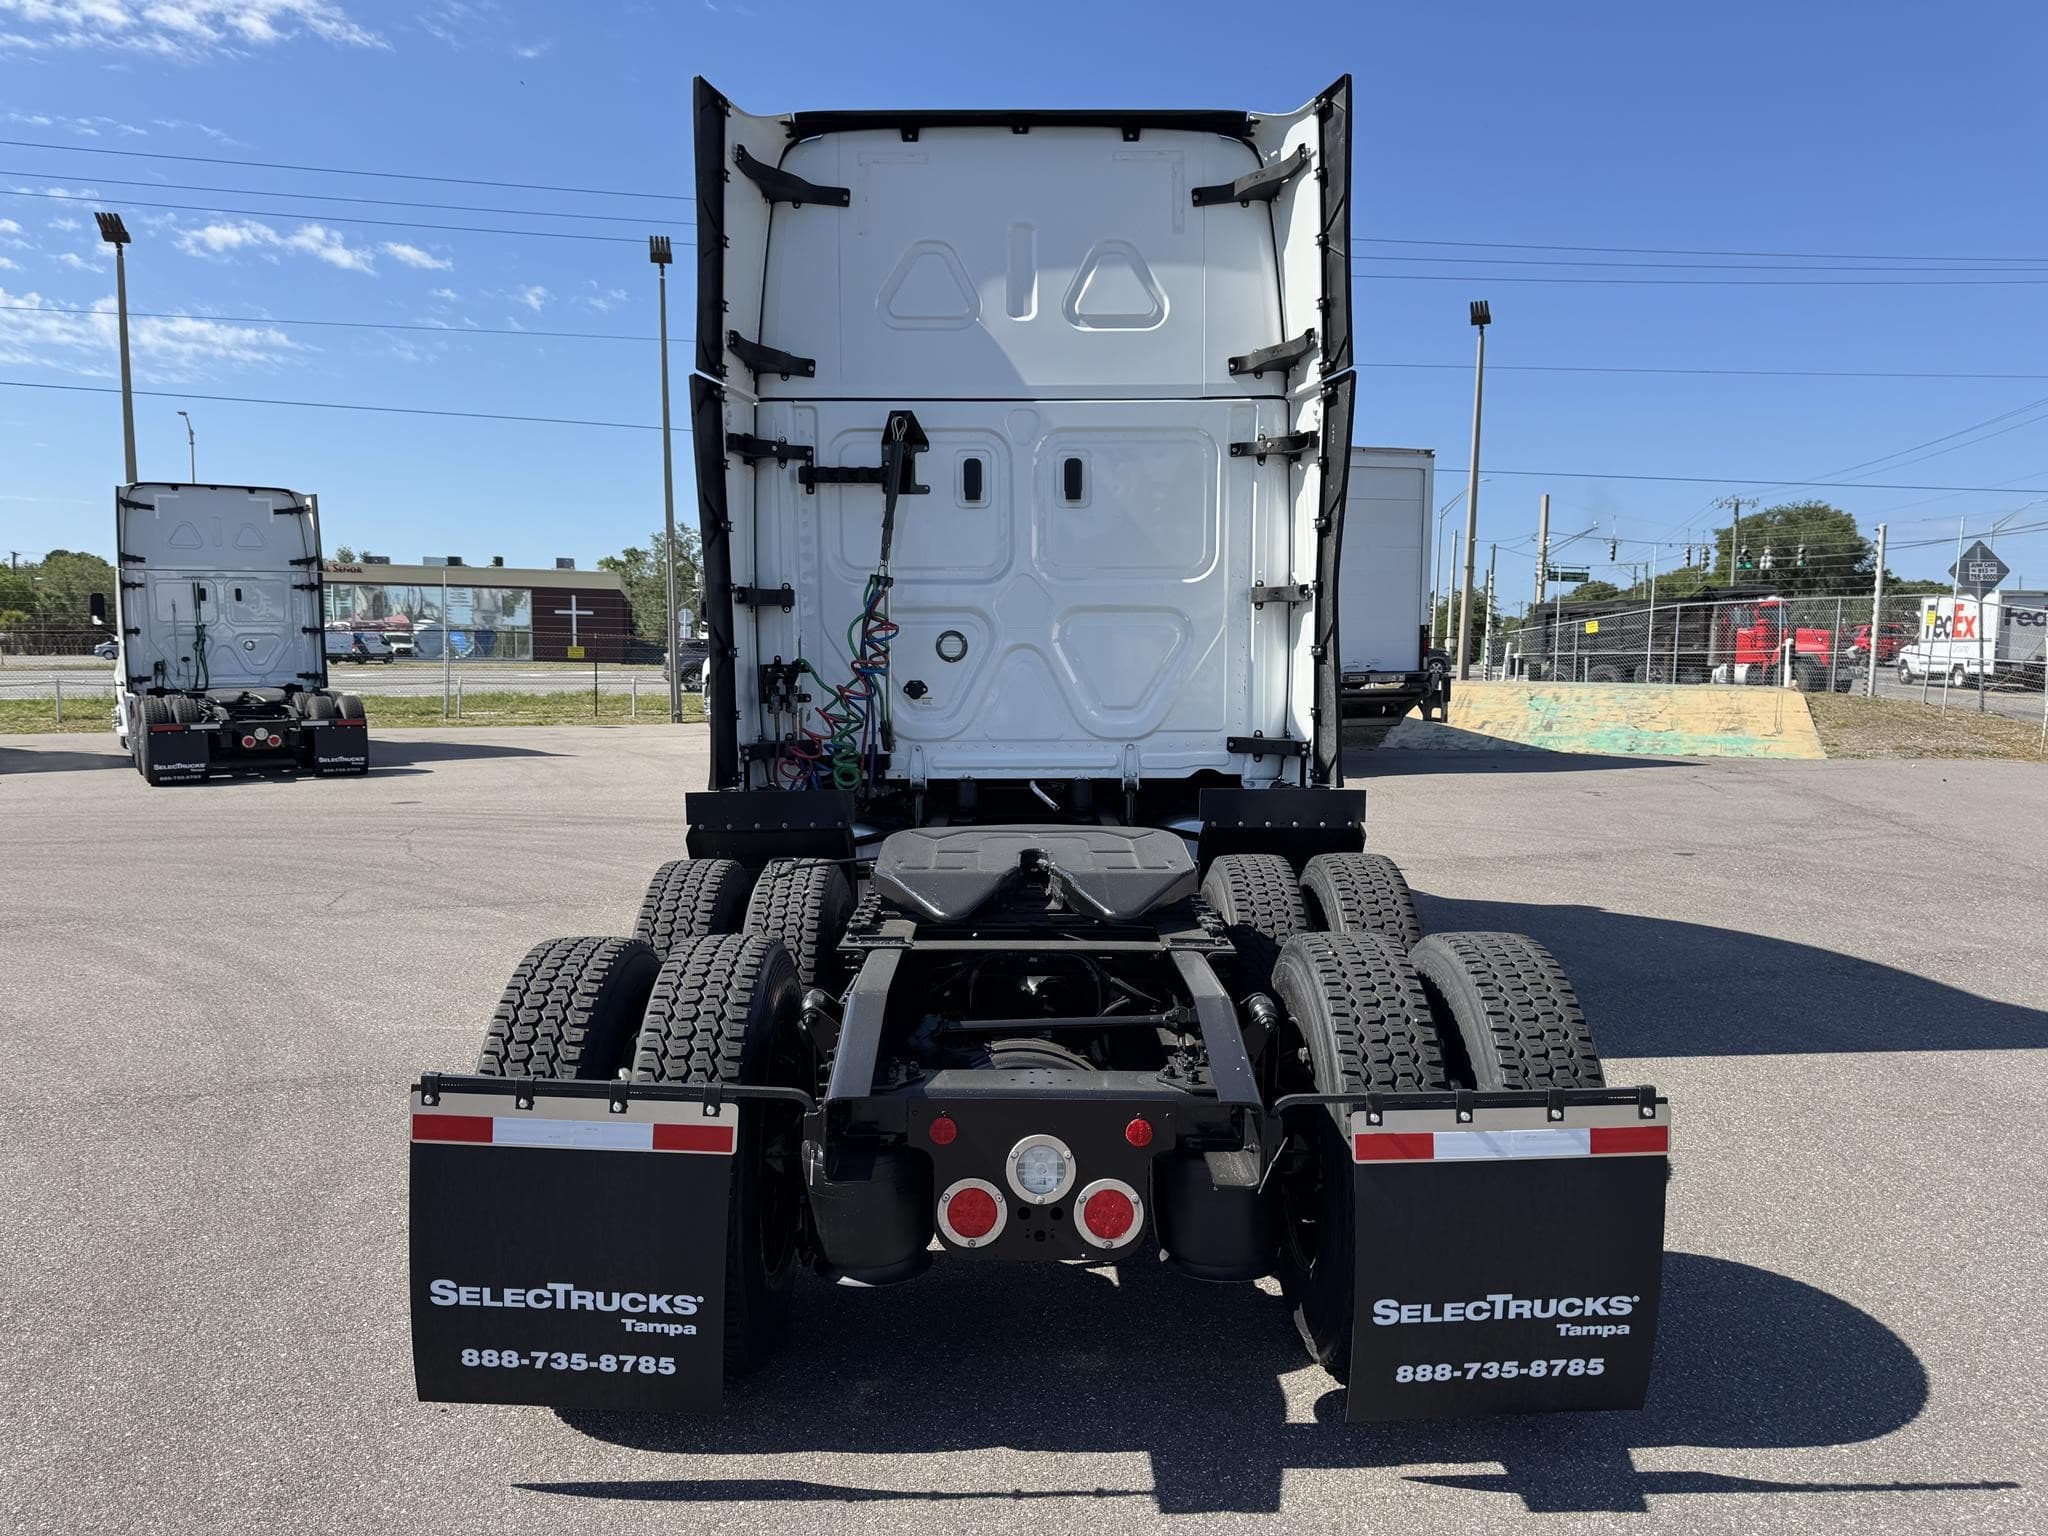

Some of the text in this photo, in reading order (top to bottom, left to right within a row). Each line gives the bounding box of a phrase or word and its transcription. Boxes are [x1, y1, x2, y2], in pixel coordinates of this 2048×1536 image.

[620, 1319, 697, 1337] Tampa
[1556, 1323, 1631, 1338] Tampa
[461, 1349, 677, 1375] 888-735-8785
[1395, 1358, 1606, 1383] 888-735-8785
